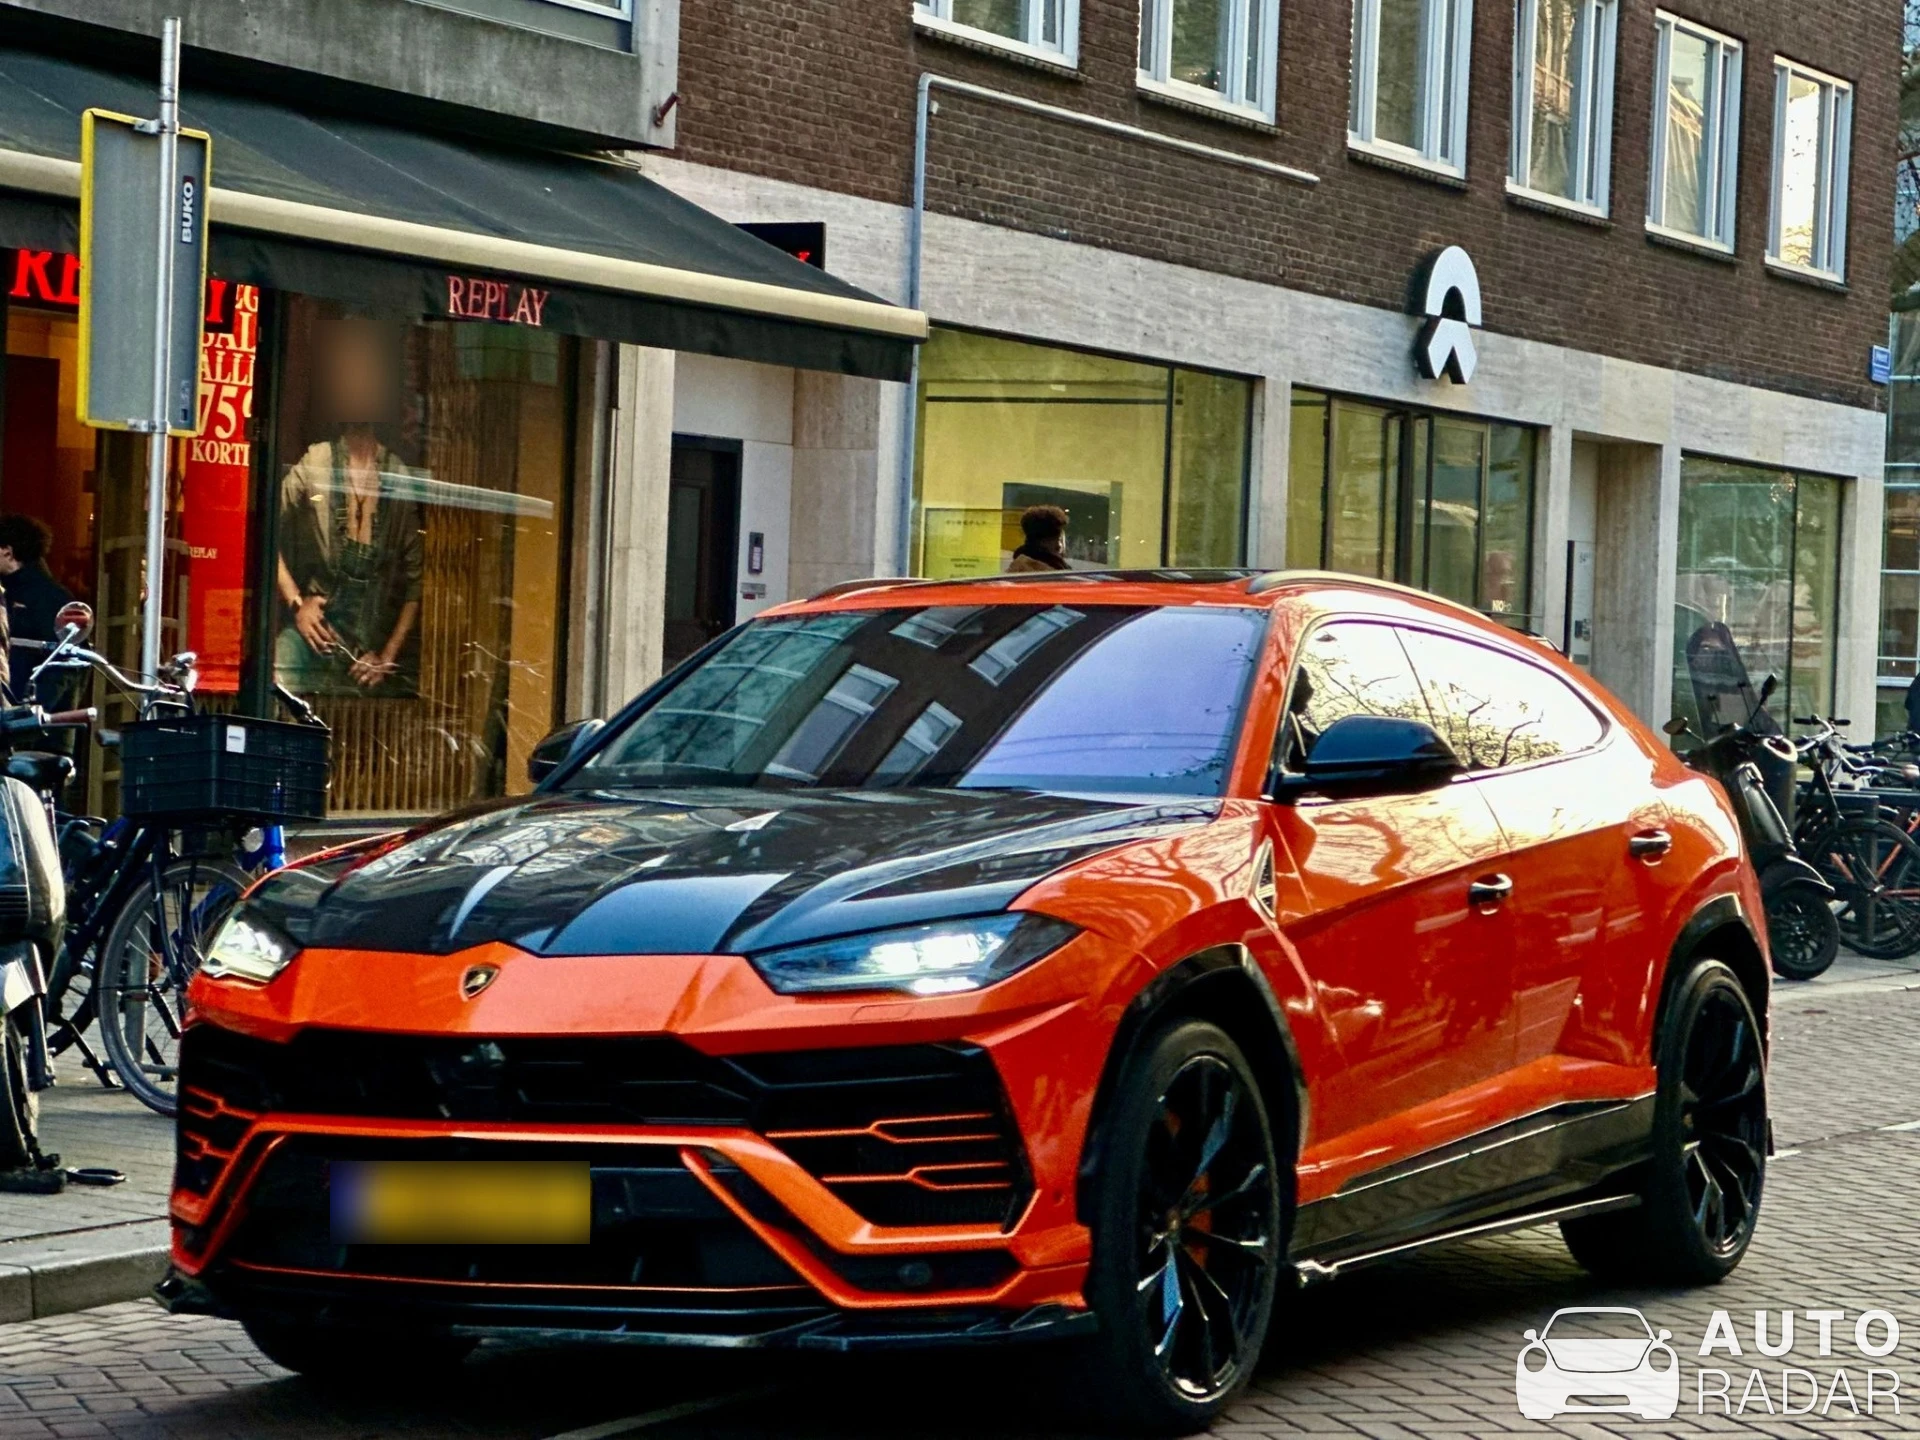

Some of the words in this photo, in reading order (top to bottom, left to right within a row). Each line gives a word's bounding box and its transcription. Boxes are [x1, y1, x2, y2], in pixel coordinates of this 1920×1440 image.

[182, 181, 194, 243] BUKO
[447, 275, 551, 327] REPLAY
[189, 546, 218, 559] REPLAY
